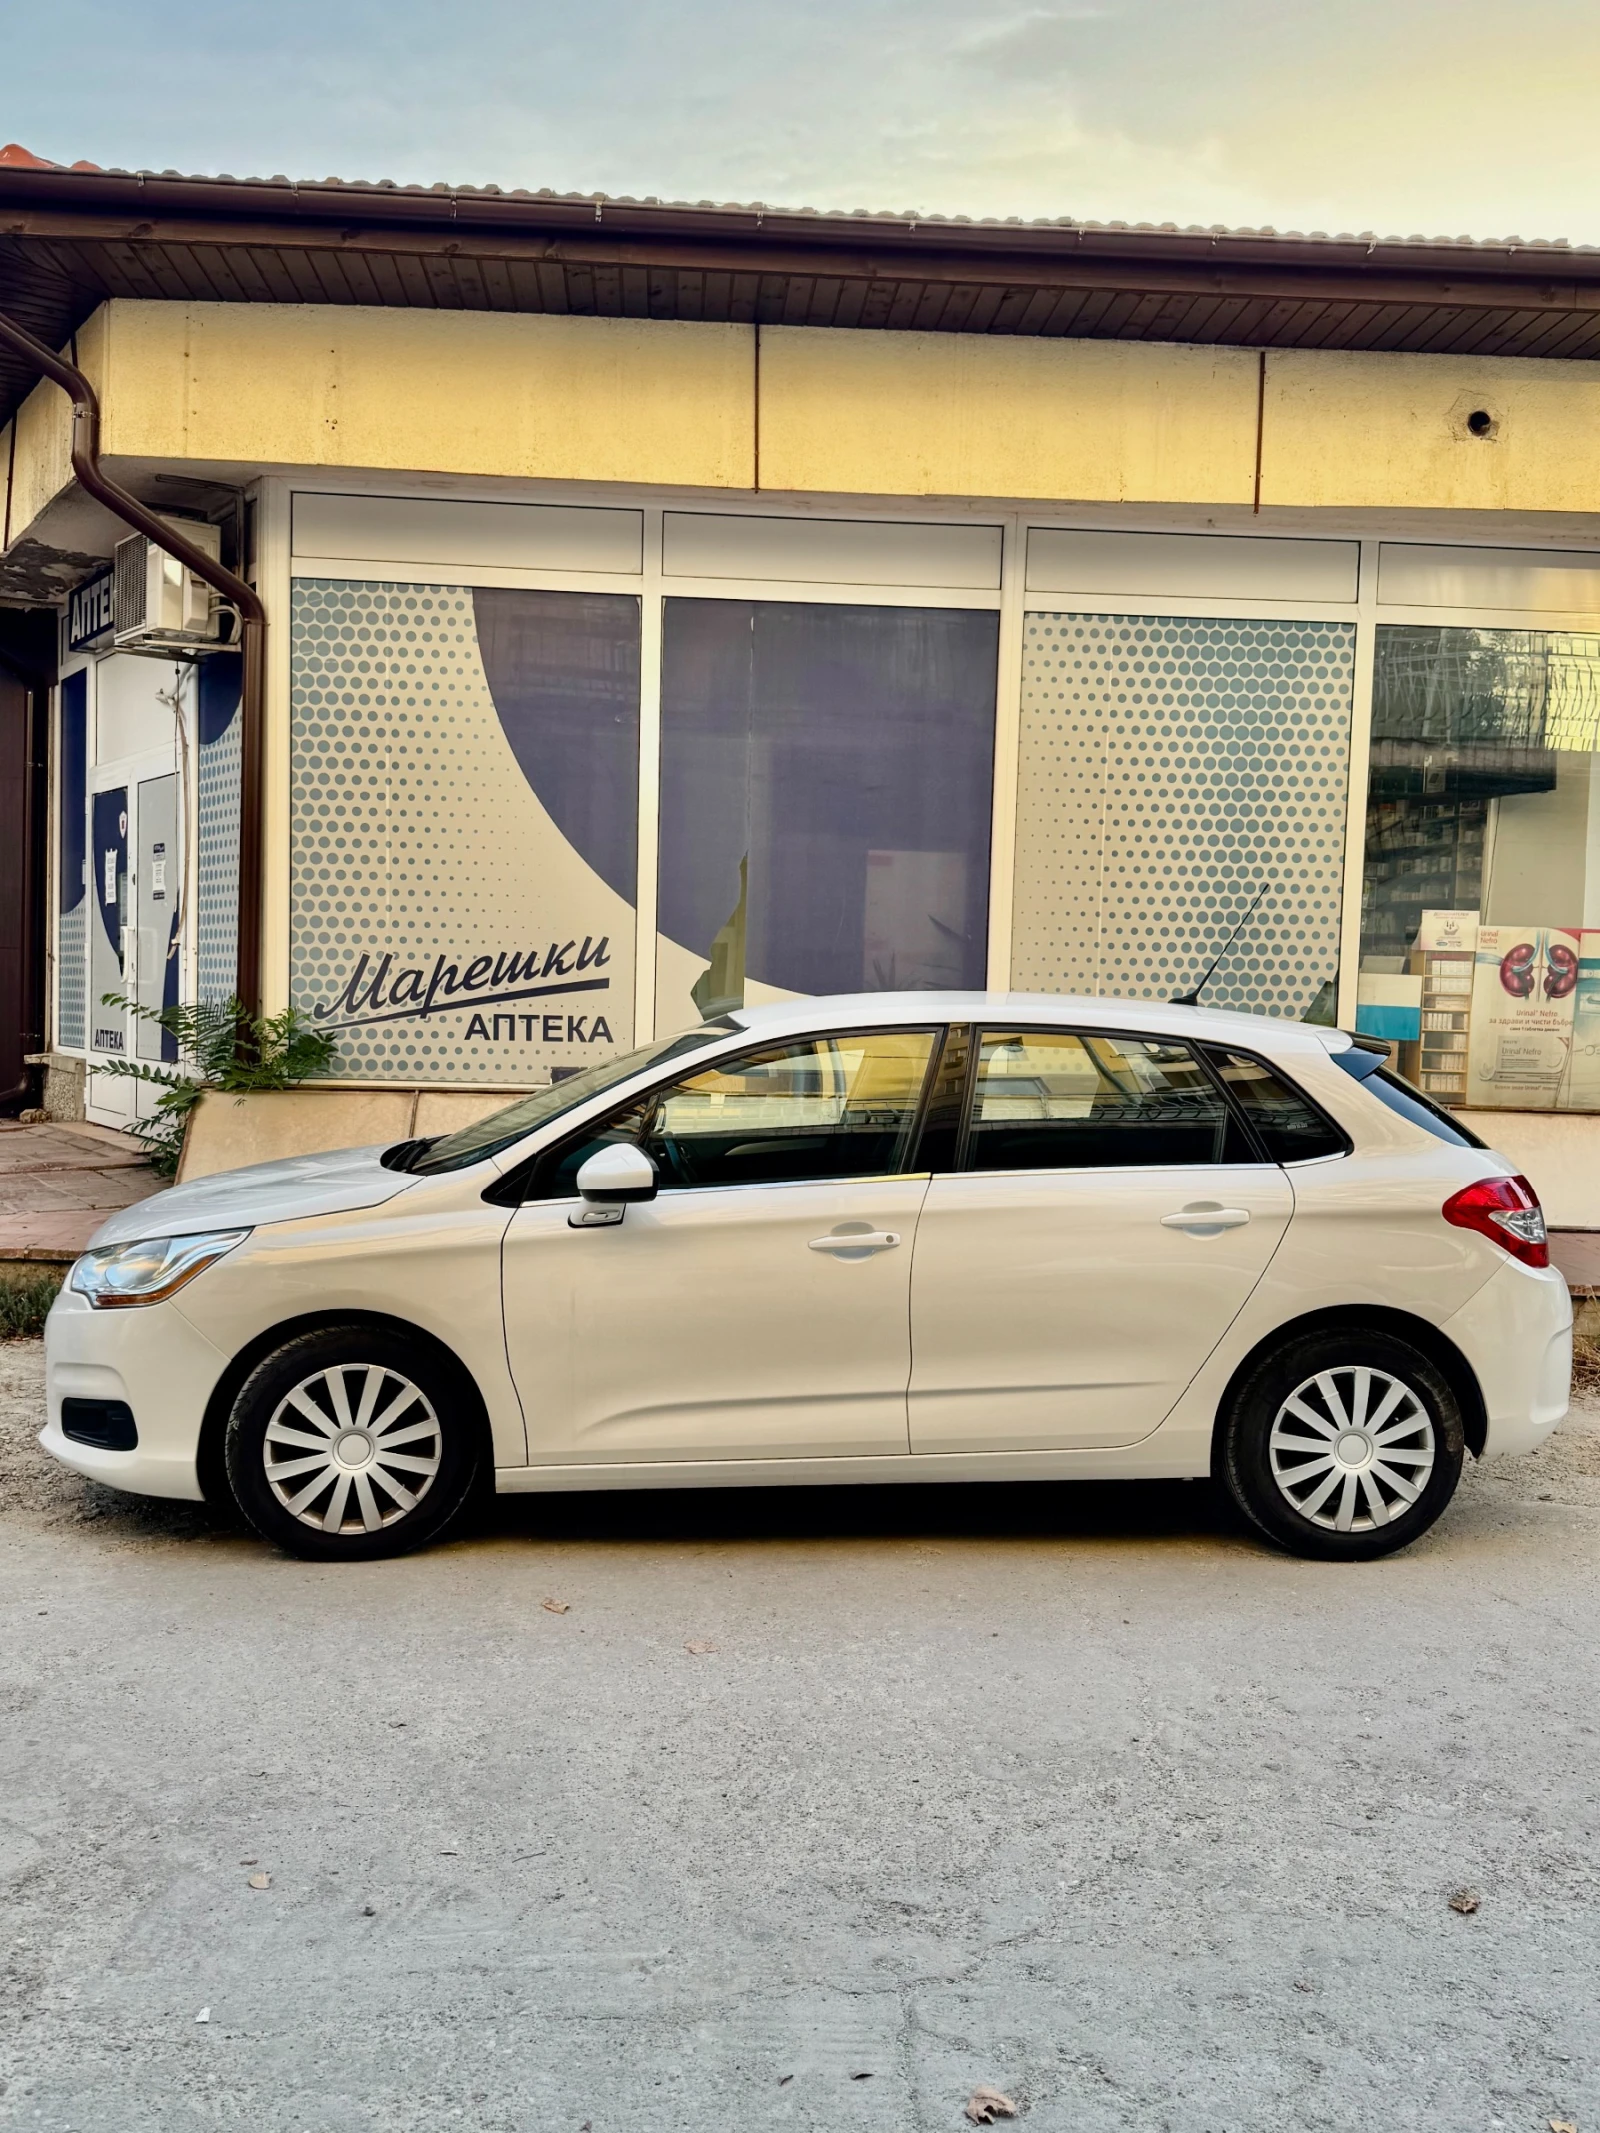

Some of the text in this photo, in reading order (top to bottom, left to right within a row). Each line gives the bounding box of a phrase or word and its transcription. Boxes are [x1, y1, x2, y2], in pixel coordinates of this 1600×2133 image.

[313, 936, 612, 1020] Марешки
[94, 1029, 124, 1050] АПТЕКА
[464, 1013, 614, 1043] АПТЕКА
